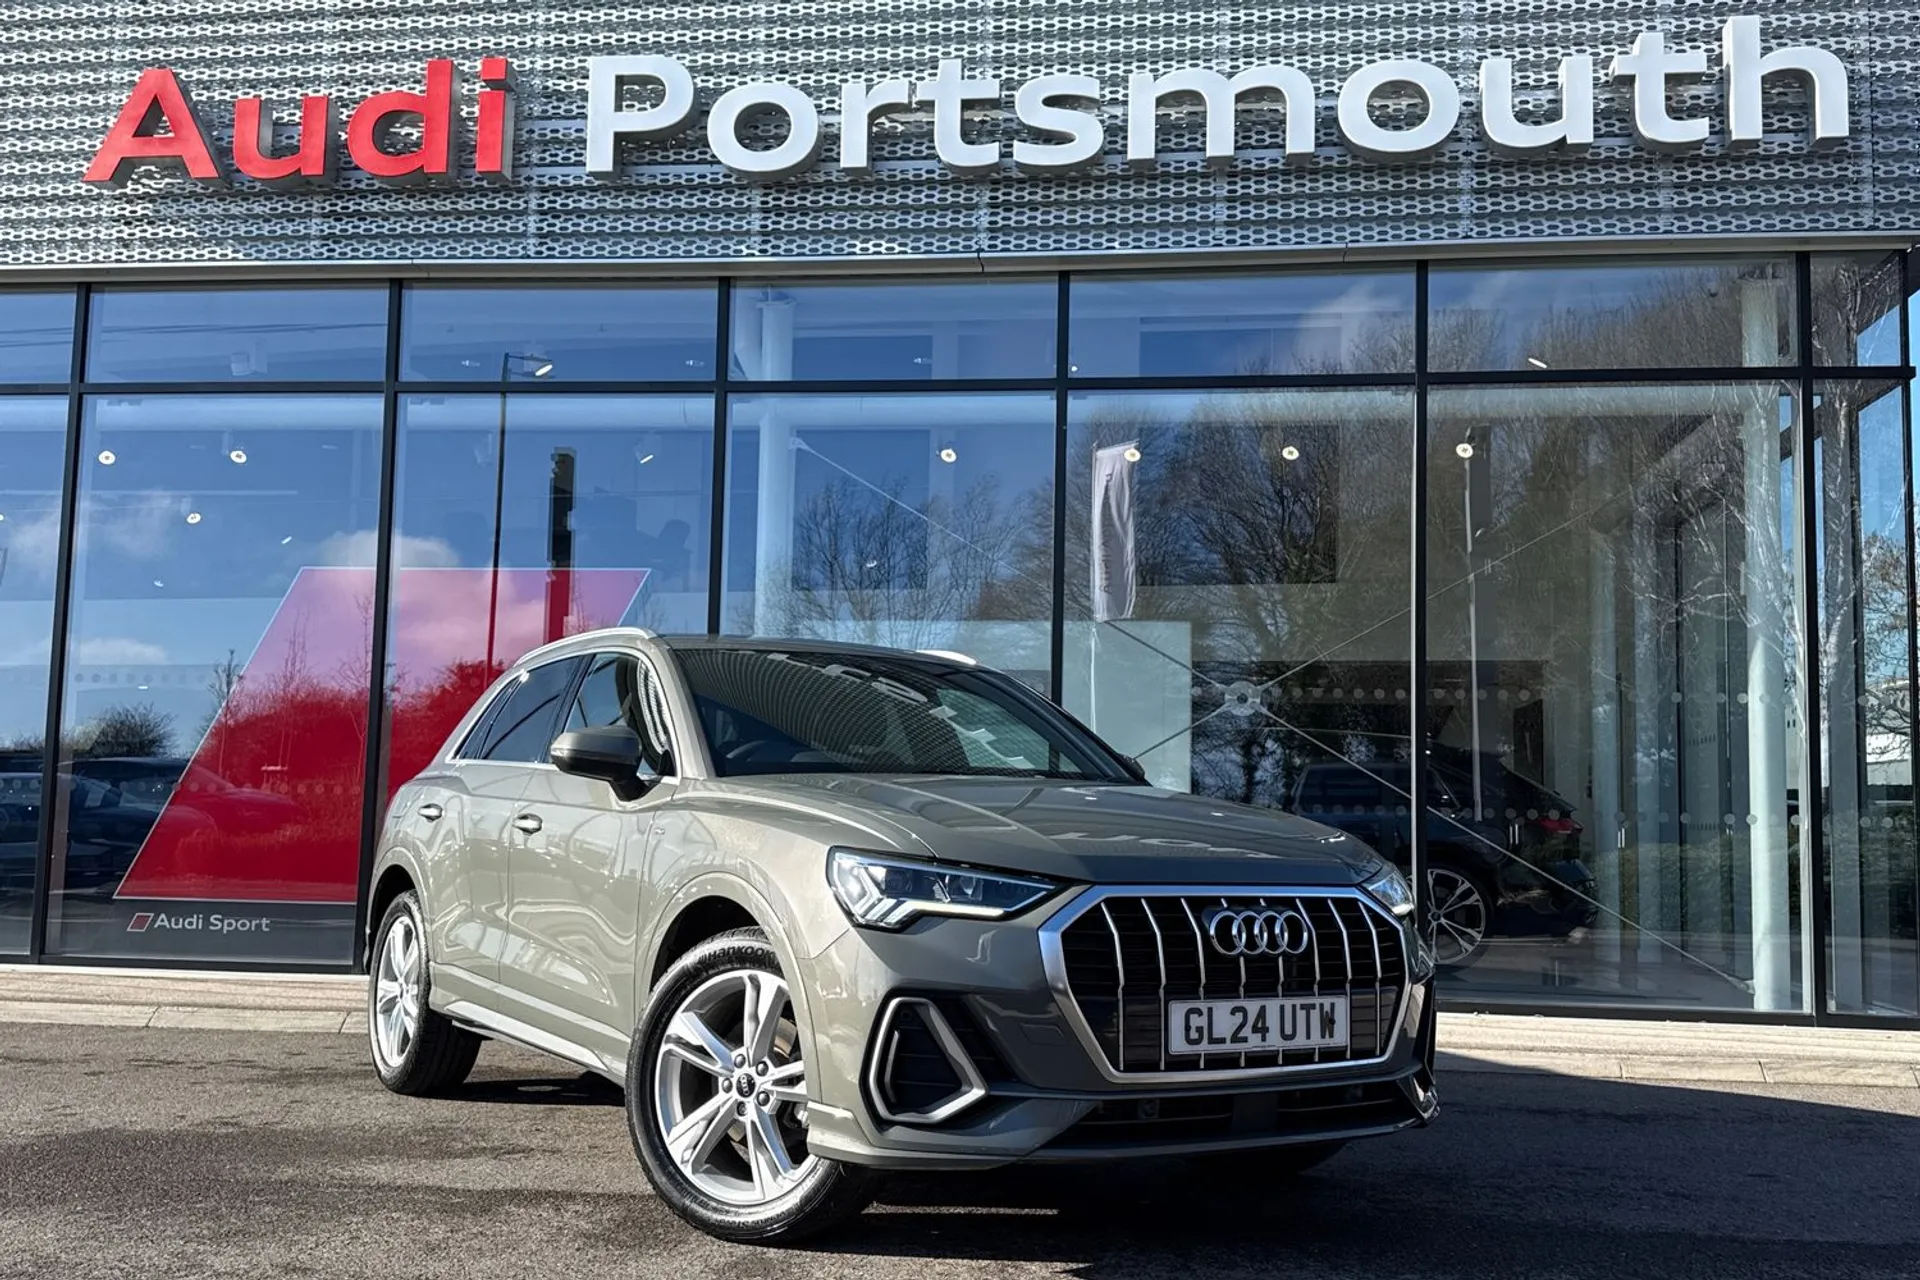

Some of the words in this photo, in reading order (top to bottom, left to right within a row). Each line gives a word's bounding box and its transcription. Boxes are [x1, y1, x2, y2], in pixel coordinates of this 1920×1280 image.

[82, 57, 513, 183] Audi
[585, 16, 1850, 174] Portsmouth
[154, 913, 203, 930] Audi
[208, 914, 271, 934] Sport
[1184, 1004, 1270, 1046] GL24
[1279, 1002, 1336, 1042] UTW
